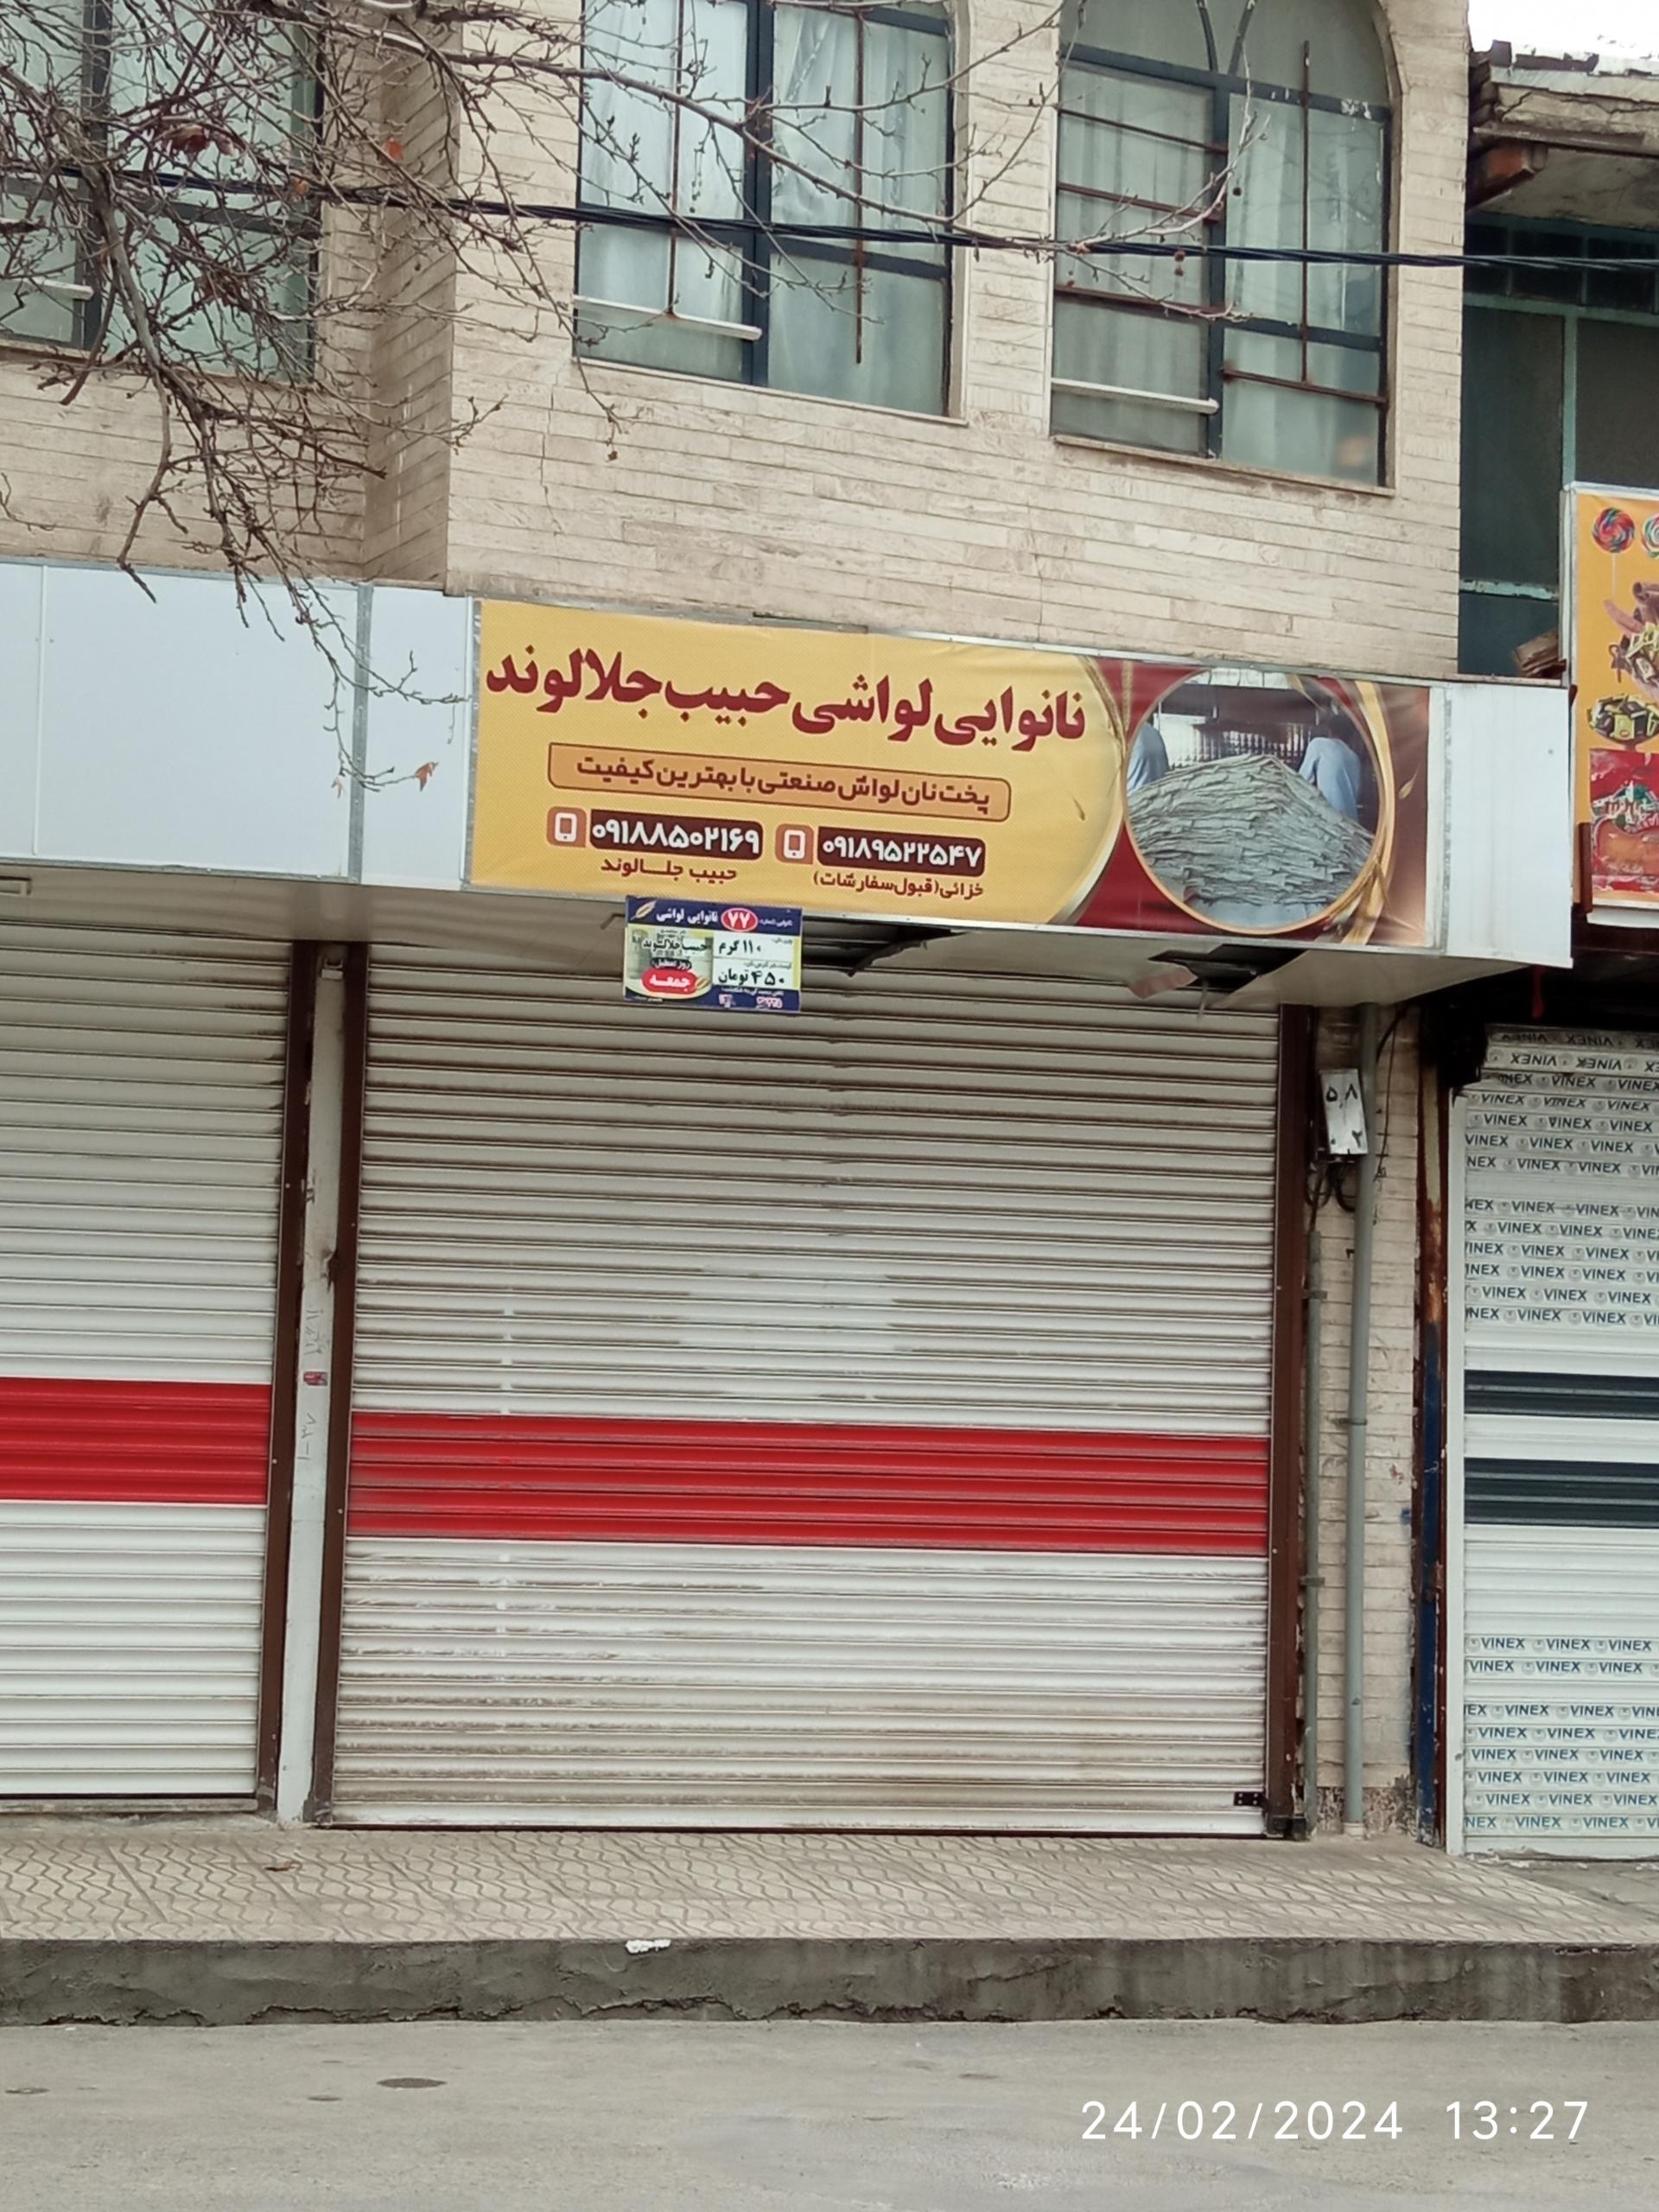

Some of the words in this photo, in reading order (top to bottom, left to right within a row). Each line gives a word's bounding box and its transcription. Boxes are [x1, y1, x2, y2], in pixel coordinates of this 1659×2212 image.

[486, 645, 663, 719] جلالوند
[664, 681, 791, 728] حبیب
[792, 674, 932, 741] لواشی
[934, 686, 1085, 752] نانوایی
[576, 756, 655, 785] کیفیت
[656, 766, 738, 792] بهترین
[740, 767, 756, 794] با
[757, 772, 836, 795] صنعتی
[837, 775, 899, 804] لواش
[901, 781, 938, 806] نان
[938, 785, 990, 815] پخت
[591, 819, 760, 855] ۰۹۱۸۸۵۰۲۱۶۹
[822, 836, 982, 868] ۰۹۱۸۹۵۲۲۵۴۷
[689, 868, 737, 885] حبیب
[657, 907, 684, 923] لواشی
[687, 910, 718, 925] نانوایی
[728, 912, 750, 929] ۷۷
[718, 968, 749, 986] تومان
[1510, 1053, 1557, 1065] VINEX
[1576, 1058, 1622, 1070] VINEX
[1551, 1076, 1596, 1088] VINEX
[1481, 1094, 1525, 1105] VINEX
[1543, 1097, 1586, 1108] VINEX
[1607, 1100, 1650, 1111] VINEX
[1484, 1115, 1527, 1127] VINEX
[1548, 1116, 1592, 1129] VINEX
[1610, 1120, 1652, 1132] VINEX
[1465, 1134, 1509, 1147] VINEX
[1529, 1137, 1573, 1150] VINEX
[1591, 1141, 1633, 1154] VINEX
[1466, 1156, 1496, 1167] NEX
[1517, 1158, 1560, 1171] VINEX
[1579, 1161, 1621, 1174] VINEX
[1512, 1201, 1555, 1213] VINEX
[1576, 1204, 1619, 1217] VINEX
[1497, 1222, 1541, 1234] VINEX
[1560, 1224, 1603, 1236] VINEX
[1623, 1228, 1659, 1240] VINE
[1522, 1244, 1565, 1257] VINEX
[1586, 1247, 1629, 1261] VINEX
[1466, 1264, 1499, 1275] INEX
[1521, 1266, 1564, 1279] VINEX
[1582, 1268, 1625, 1281] VINEX
[1482, 1287, 1526, 1300] VINEX
[1544, 1288, 1587, 1301] VINEX
[1607, 1292, 1651, 1305] VINEX
[1517, 1309, 1560, 1321] VINEX
[1582, 1312, 1625, 1325] VINEX
[1480, 1637, 1526, 1649] VINEX
[1546, 1638, 1591, 1650] VINEX
[1608, 1639, 1652, 1652] VINEX
[1469, 1661, 1514, 1672] VINEX
[1536, 1661, 1580, 1673] VINEX
[1599, 1662, 1643, 1674] VINEX
[1505, 1704, 1549, 1716] VINEX
[1571, 1705, 1614, 1717] VINEX
[1478, 1727, 1527, 1739] VINEX
[1548, 1727, 1595, 1739] VINEX
[1618, 1728, 1659, 1740] VINE
[1471, 1749, 1516, 1761] VINEX
[1535, 1749, 1579, 1761] VINEX
[1600, 1750, 1643, 1762] VINEX
[1478, 1771, 1522, 1783] VINEX
[1543, 1771, 1588, 1783] VINEX
[1606, 1772, 1650, 1784] VINEX
[1486, 1794, 1530, 1805] VINEX
[1548, 1794, 1592, 1805] VINEX
[1614, 1794, 1658, 1806] VINEX
[1465, 1816, 1497, 1828] NEX
[1515, 1816, 1560, 1828] VINEX
[1582, 1817, 1629, 1829] VINEX
